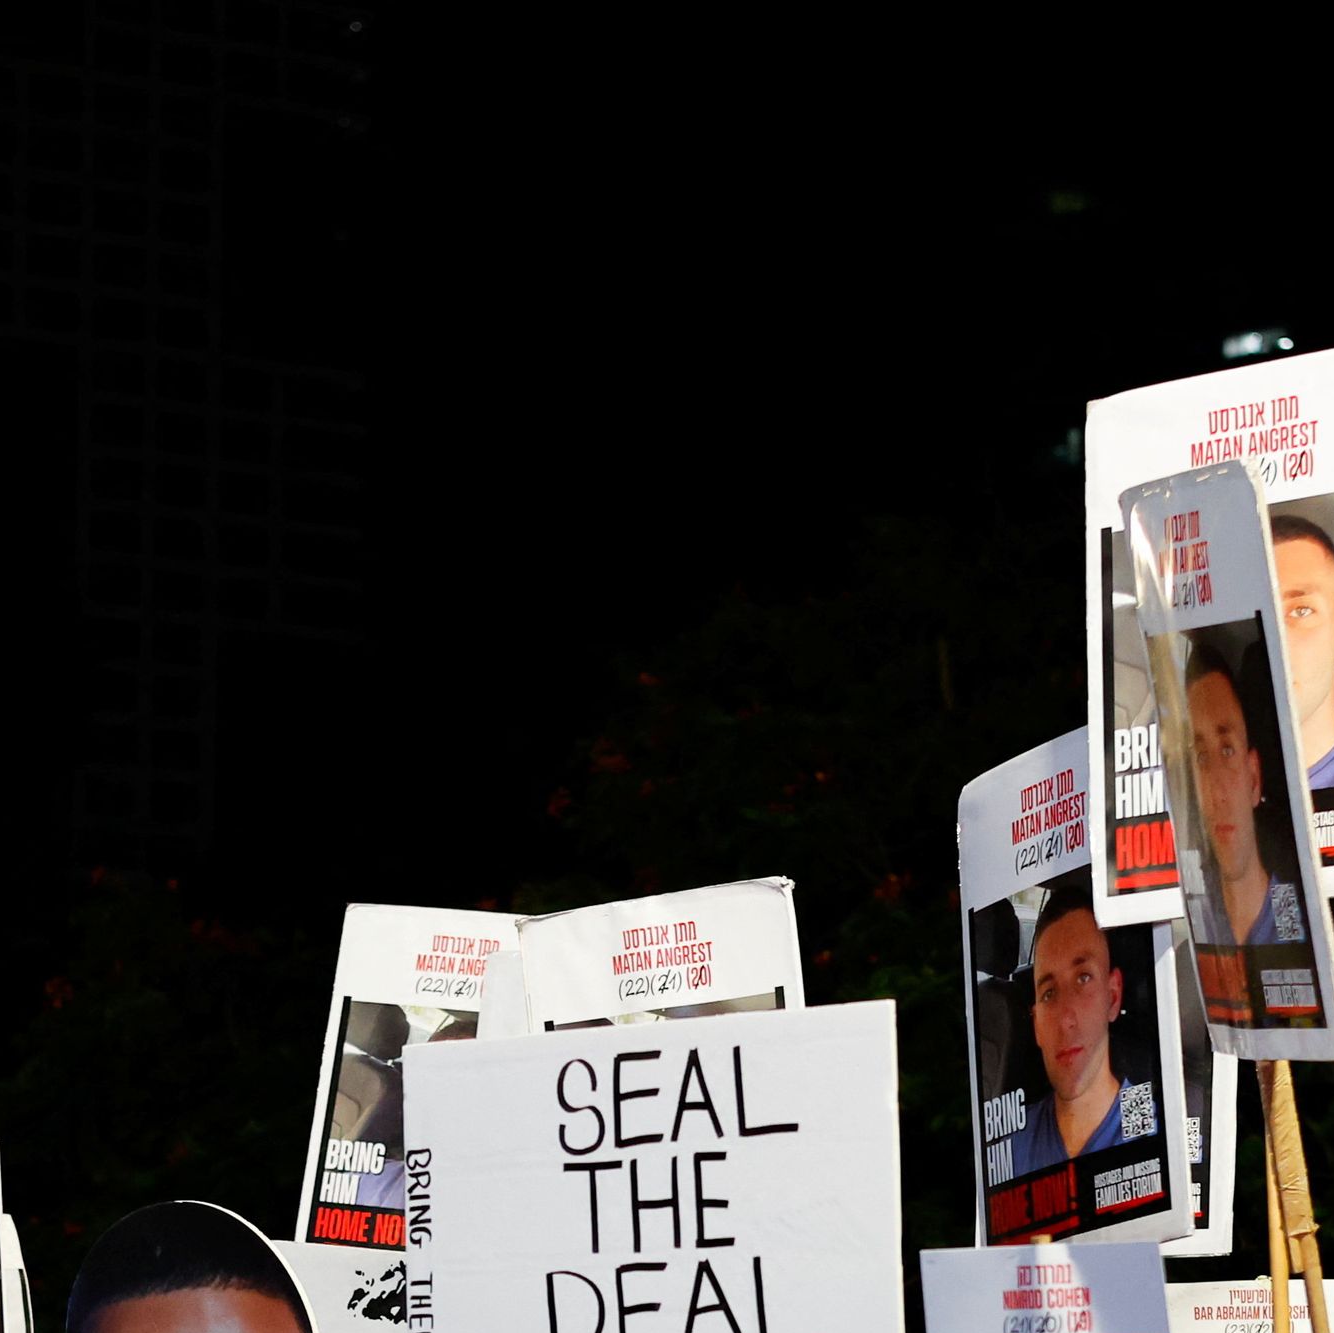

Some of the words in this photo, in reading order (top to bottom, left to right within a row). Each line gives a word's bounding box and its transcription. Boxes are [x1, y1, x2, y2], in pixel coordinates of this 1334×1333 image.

[1271, 395, 1299, 429] מתן
[1191, 434, 1243, 468] MATAN
[1249, 420, 1318, 458] ANGREST
[1114, 770, 1165, 819] HIM
[1012, 811, 1041, 846] MATAN
[1044, 791, 1085, 831] ANGREST
[622, 925, 669, 950] אנגרסט
[673, 921, 697, 943] מתן
[416, 954, 454, 975] MATAN
[612, 951, 652, 976] MATAN
[656, 941, 713, 968] ANGREST
[557, 1045, 799, 1156] SEAL
[983, 1088, 1027, 1142] BRING
[324, 1138, 387, 1175] BRING
[986, 1138, 1014, 1187] HIM
[320, 1170, 359, 1205] HIM
[406, 1149, 432, 1249] BRING
[563, 1151, 736, 1253] THE
[1095, 1180, 1132, 1209] FAMILIES
[1133, 1172, 1162, 1200] FORUM
[314, 1206, 371, 1242] HOME
[373, 1211, 406, 1246] NO
[1047, 1287, 1091, 1308] COHEN
[1194, 1306, 1213, 1321] BAR
[1216, 1306, 1260, 1321] ABRAHAM
